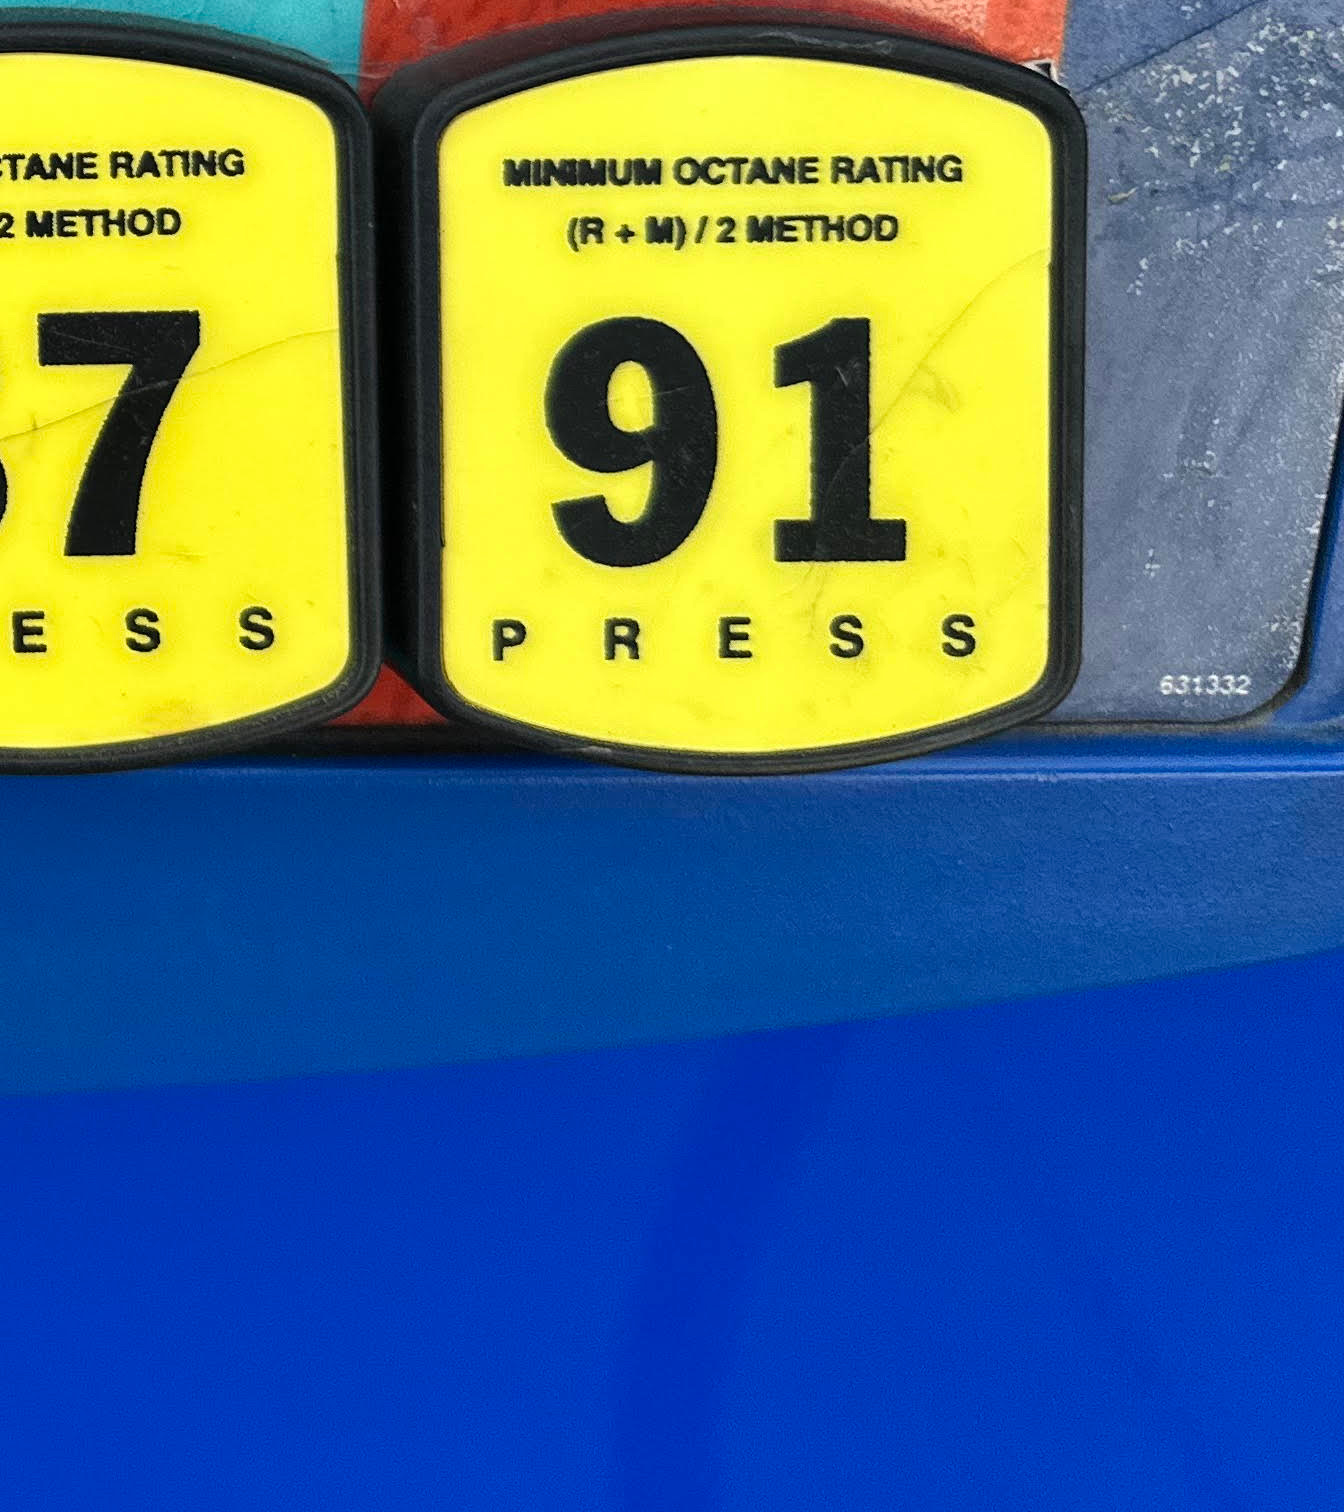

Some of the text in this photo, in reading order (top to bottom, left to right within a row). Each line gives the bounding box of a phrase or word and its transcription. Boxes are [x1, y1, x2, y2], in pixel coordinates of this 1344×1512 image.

[109, 149, 245, 179] RATING
[502, 154, 963, 187] MINIMUM OCTANE RATING
[25, 208, 182, 237] METHOD
[717, 216, 736, 243] 2
[746, 214, 899, 243] METHOD
[543, 316, 908, 569] 91
[1159, 674, 1251, 696] 631332
